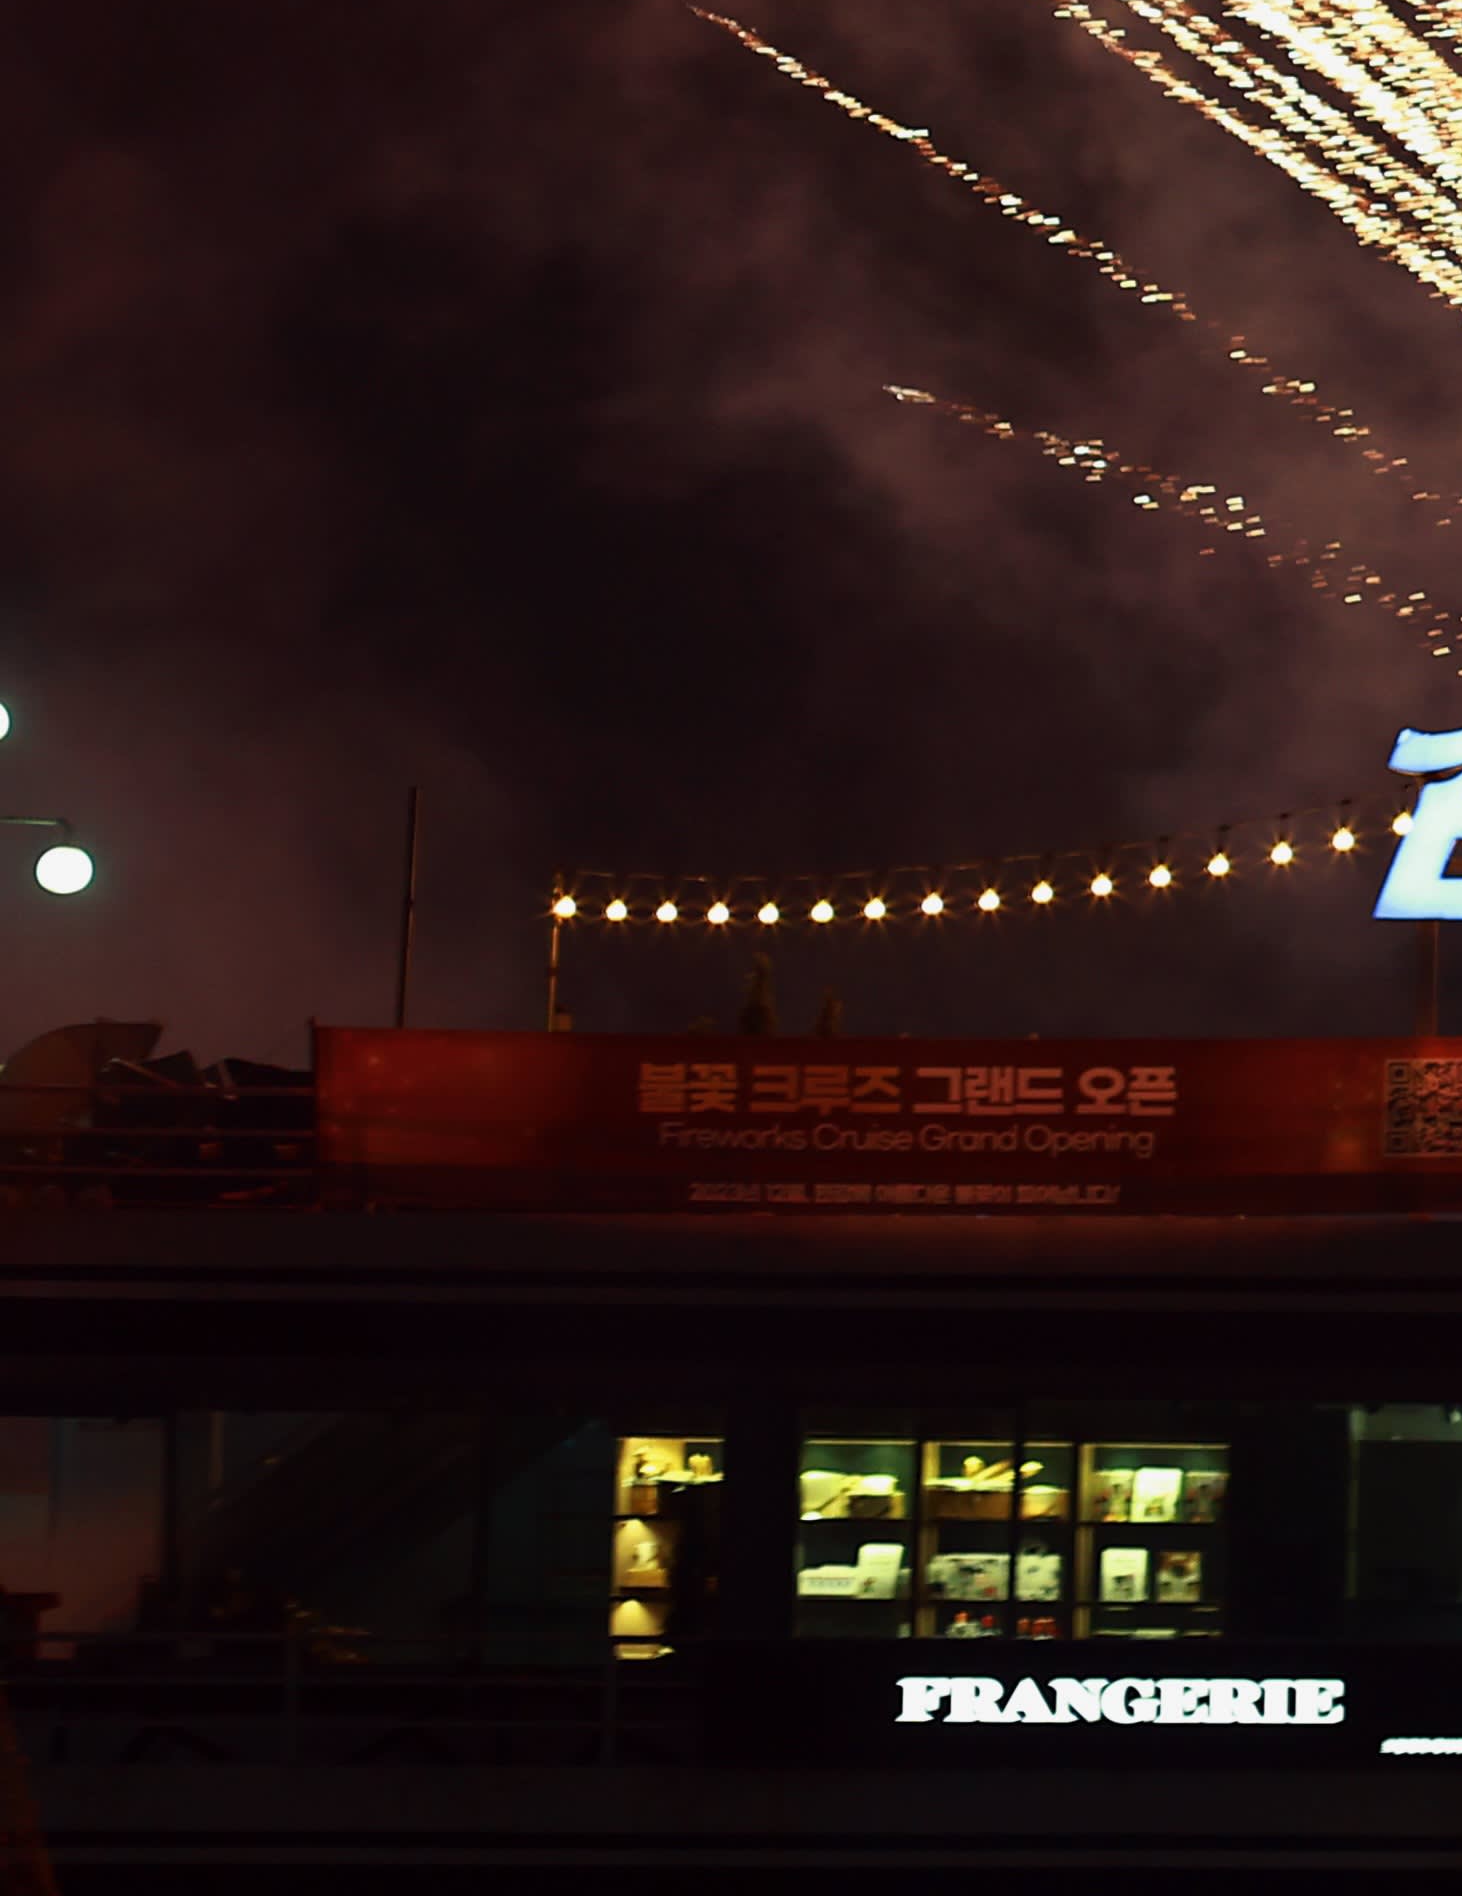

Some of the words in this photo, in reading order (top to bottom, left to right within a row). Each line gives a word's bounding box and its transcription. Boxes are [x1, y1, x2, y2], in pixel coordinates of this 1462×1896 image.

[638, 1063, 738, 1114] 불꽃
[750, 1064, 901, 1116] 크루즈
[911, 1065, 1064, 1116] 그랜드
[1076, 1065, 1177, 1117] 오픈
[658, 1122, 806, 1152] Fireworks
[813, 1123, 913, 1152] Cruise
[919, 1122, 1018, 1152] Grand
[1024, 1123, 1155, 1160] Opening
[894, 1675, 1347, 1725] FRANGERIE
